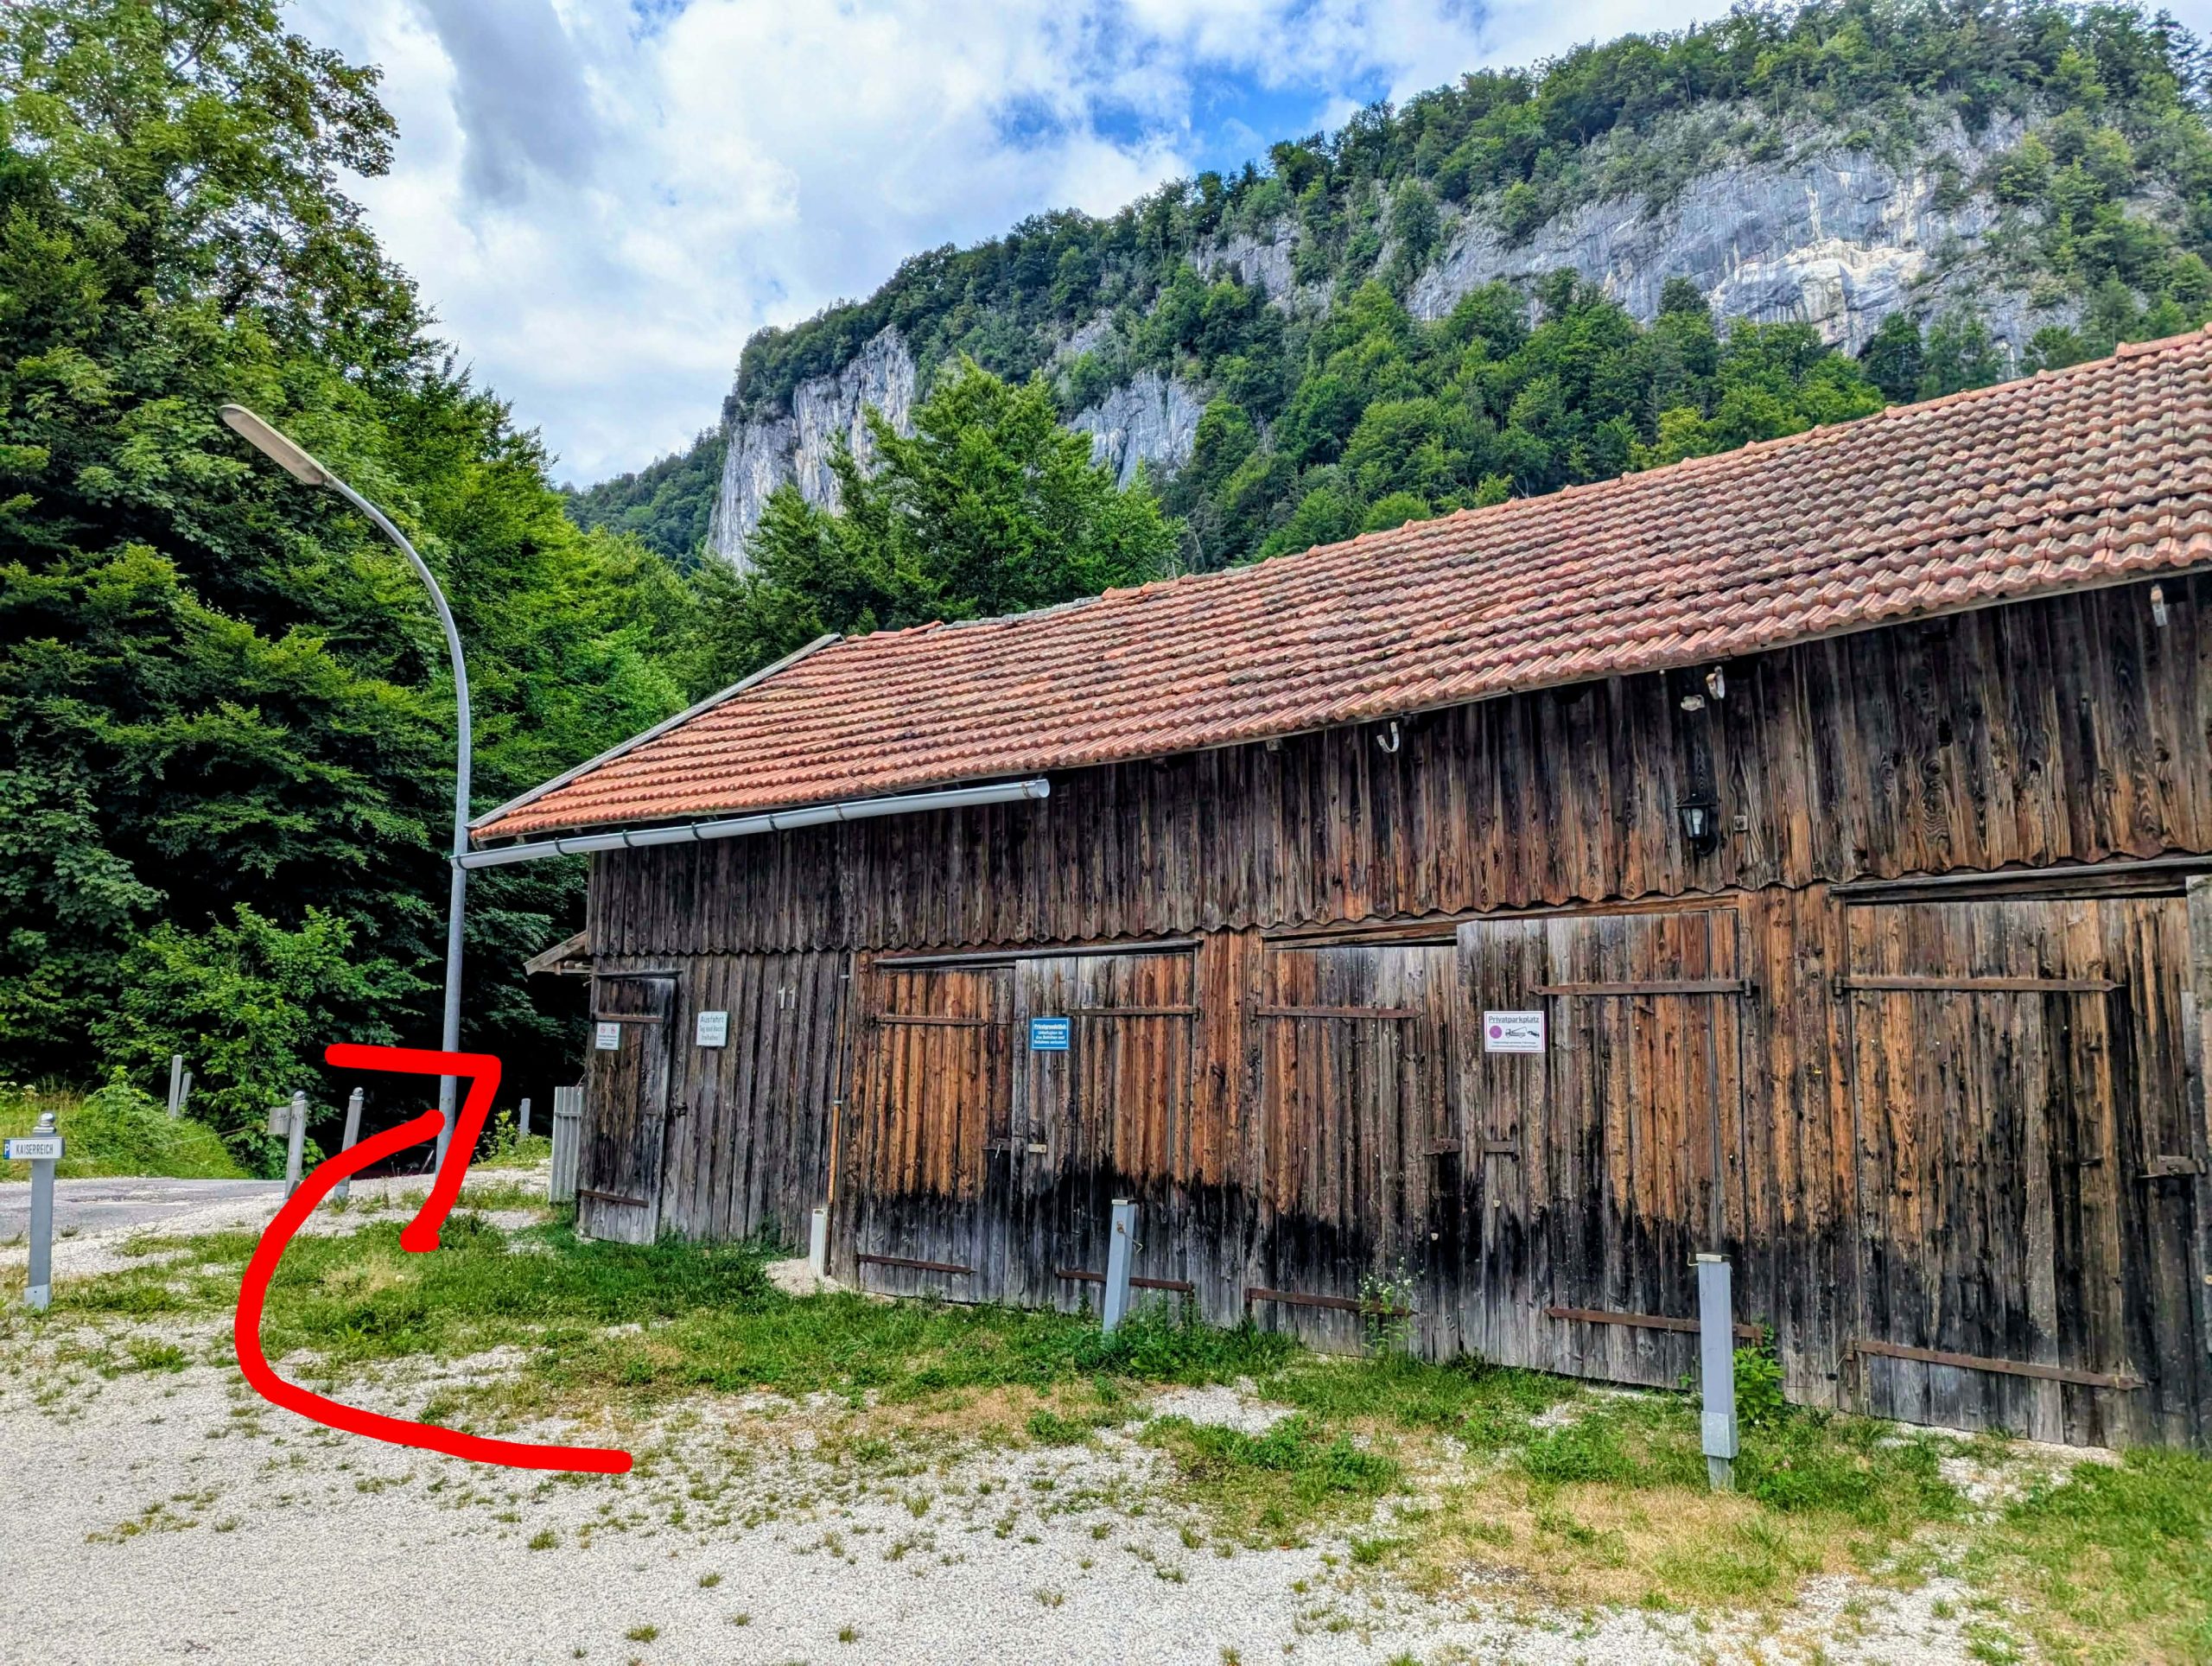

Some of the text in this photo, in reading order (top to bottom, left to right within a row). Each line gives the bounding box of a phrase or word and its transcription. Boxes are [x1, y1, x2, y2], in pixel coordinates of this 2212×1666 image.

[778, 987, 796, 1008] 11
[1489, 1015, 1540, 1024] Privatparkplatz
[16, 1143, 54, 1155] KAISERREICH
